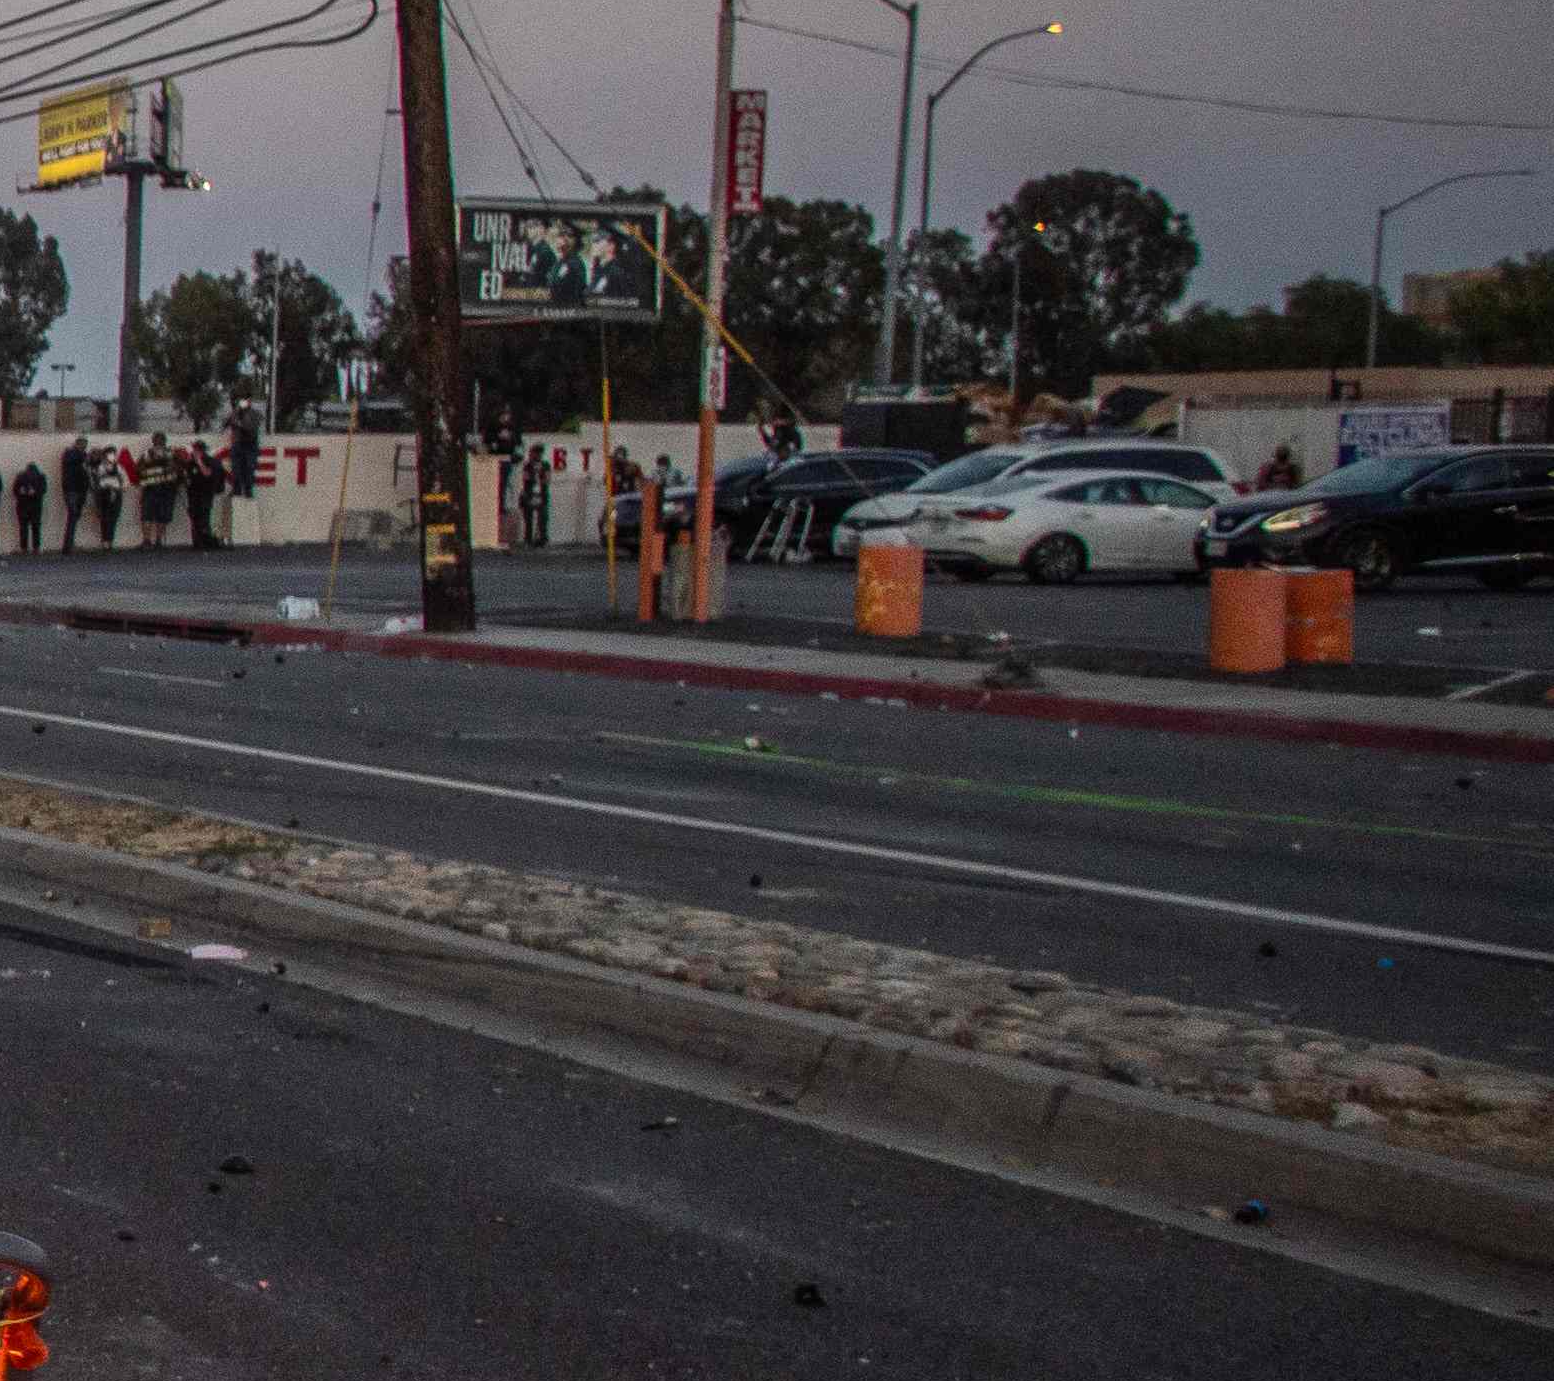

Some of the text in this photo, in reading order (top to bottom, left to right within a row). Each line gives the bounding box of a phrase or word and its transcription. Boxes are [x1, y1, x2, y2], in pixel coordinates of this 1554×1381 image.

[733, 92, 764, 211] MARKET
[473, 212, 512, 243] UNR
[492, 243, 532, 273] IVAL
[479, 269, 503, 301] ED
